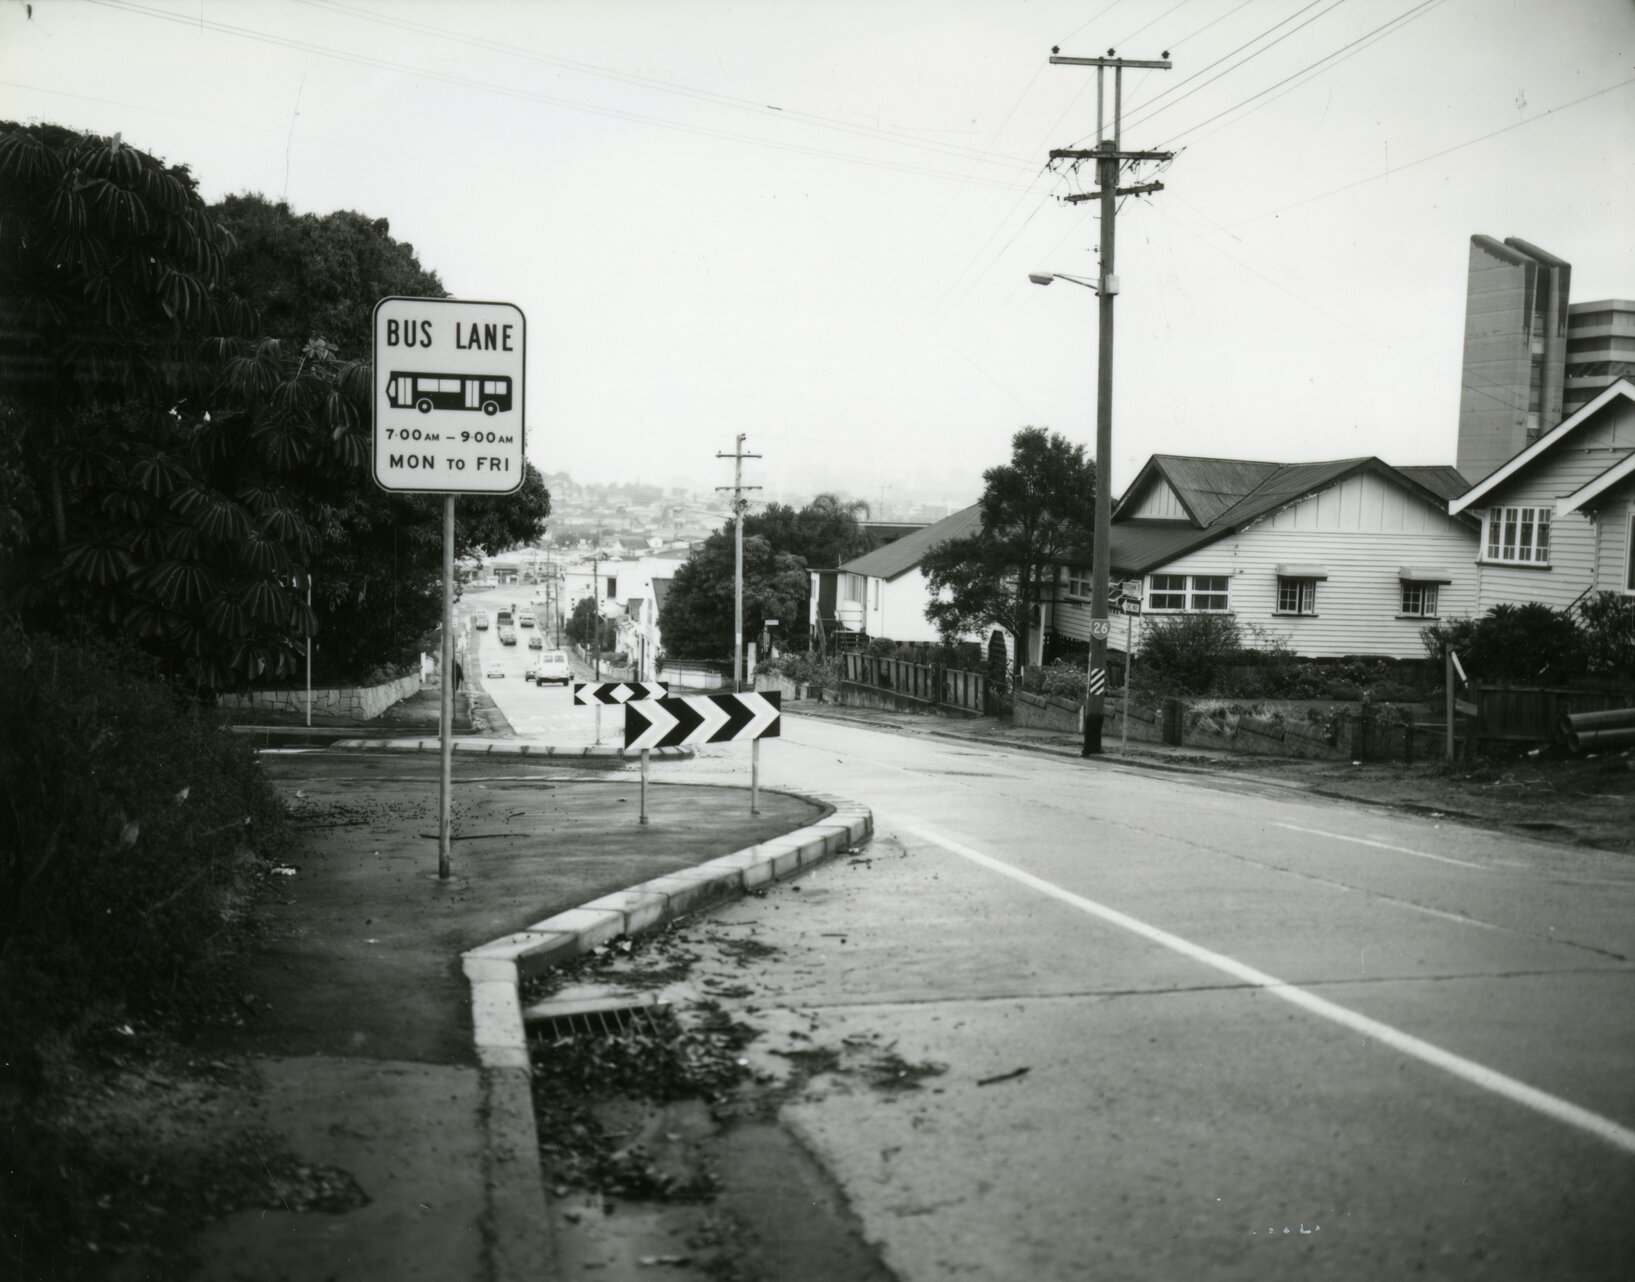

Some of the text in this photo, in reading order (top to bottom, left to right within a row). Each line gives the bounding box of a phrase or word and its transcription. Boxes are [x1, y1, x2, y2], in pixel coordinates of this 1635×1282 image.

[387, 319, 513, 351] BUS LANE
[389, 454, 509, 471] MON TO FRI
[1094, 622, 1108, 634] 26
